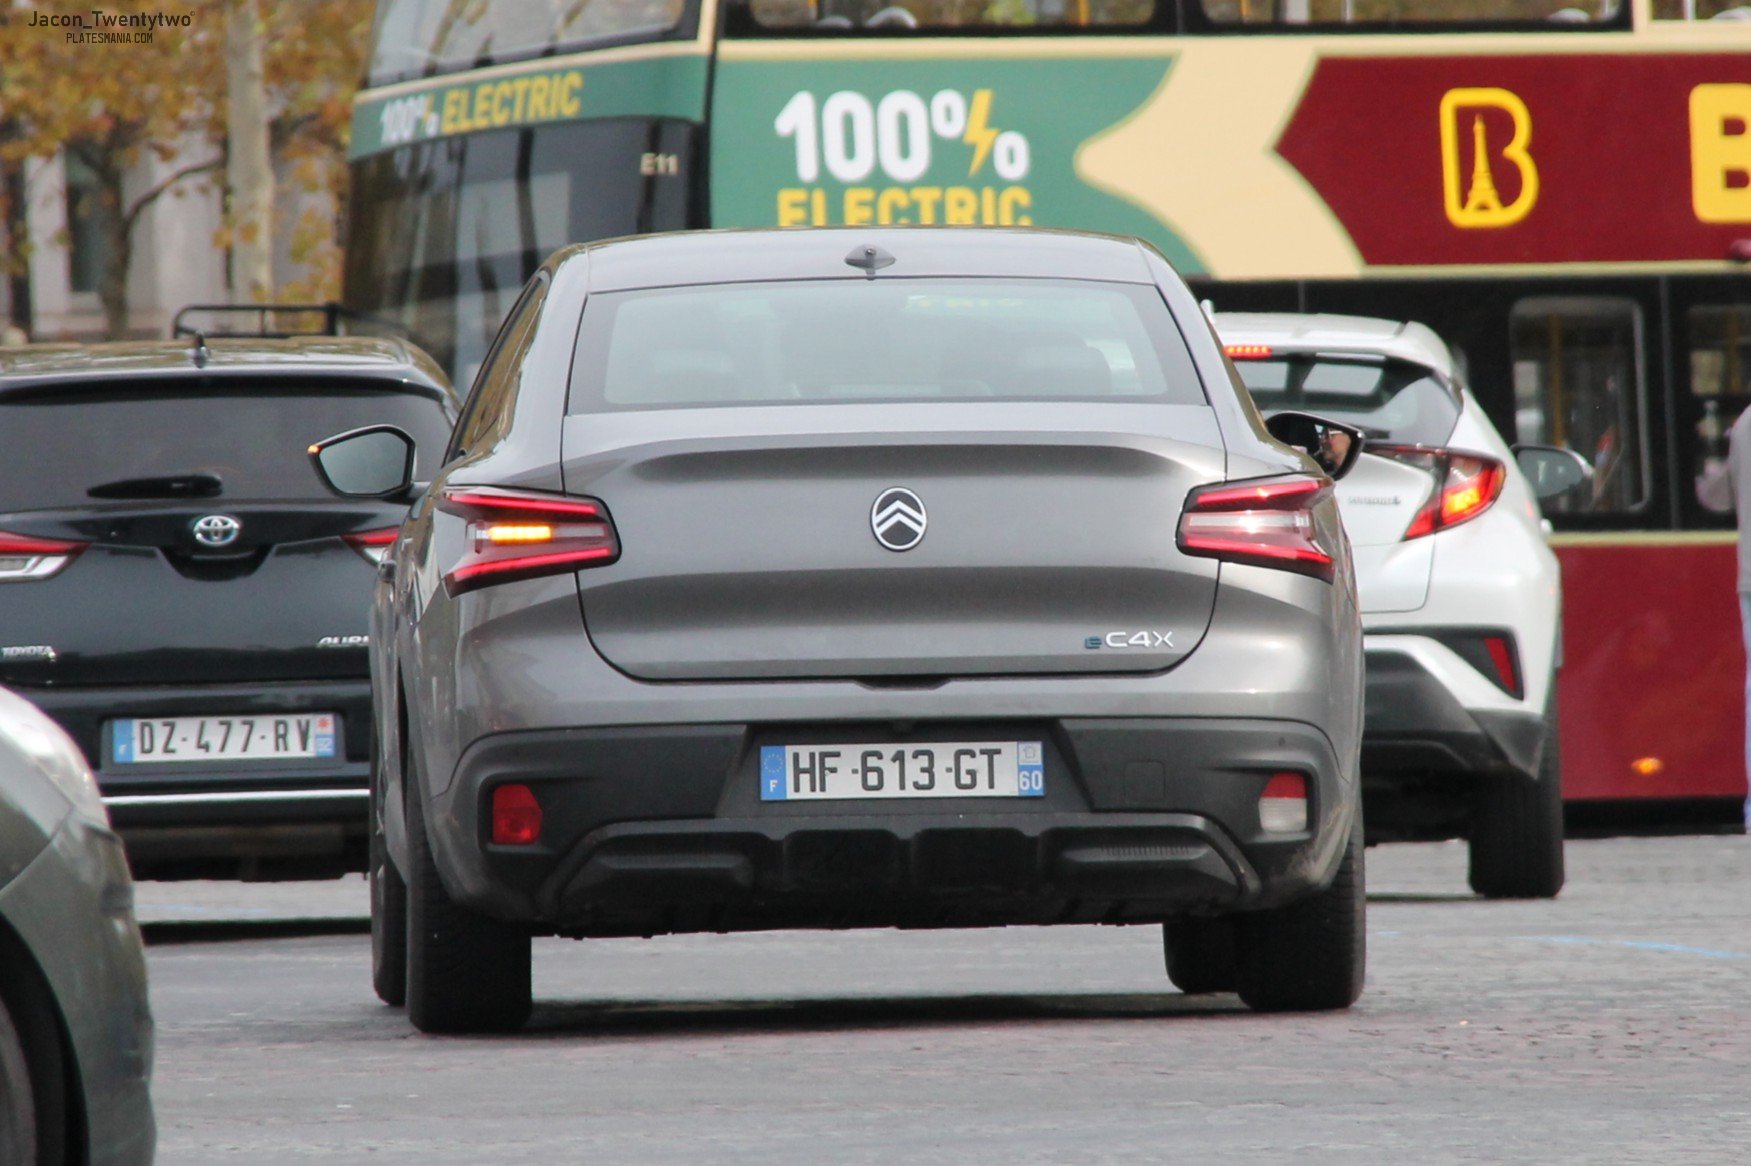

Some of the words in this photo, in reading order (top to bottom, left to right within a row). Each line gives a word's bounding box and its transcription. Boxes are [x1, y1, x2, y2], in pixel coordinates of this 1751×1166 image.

[441, 71, 584, 135] ELECTRIC
[774, 89, 1030, 183] 100%
[640, 153, 680, 176] E11
[317, 635, 369, 648] AURI
[139, 718, 311, 755] DZ-477-RV
[769, 779, 778, 793] F
[792, 748, 1002, 793] HF-613-GT
[1019, 769, 1043, 791] 60
